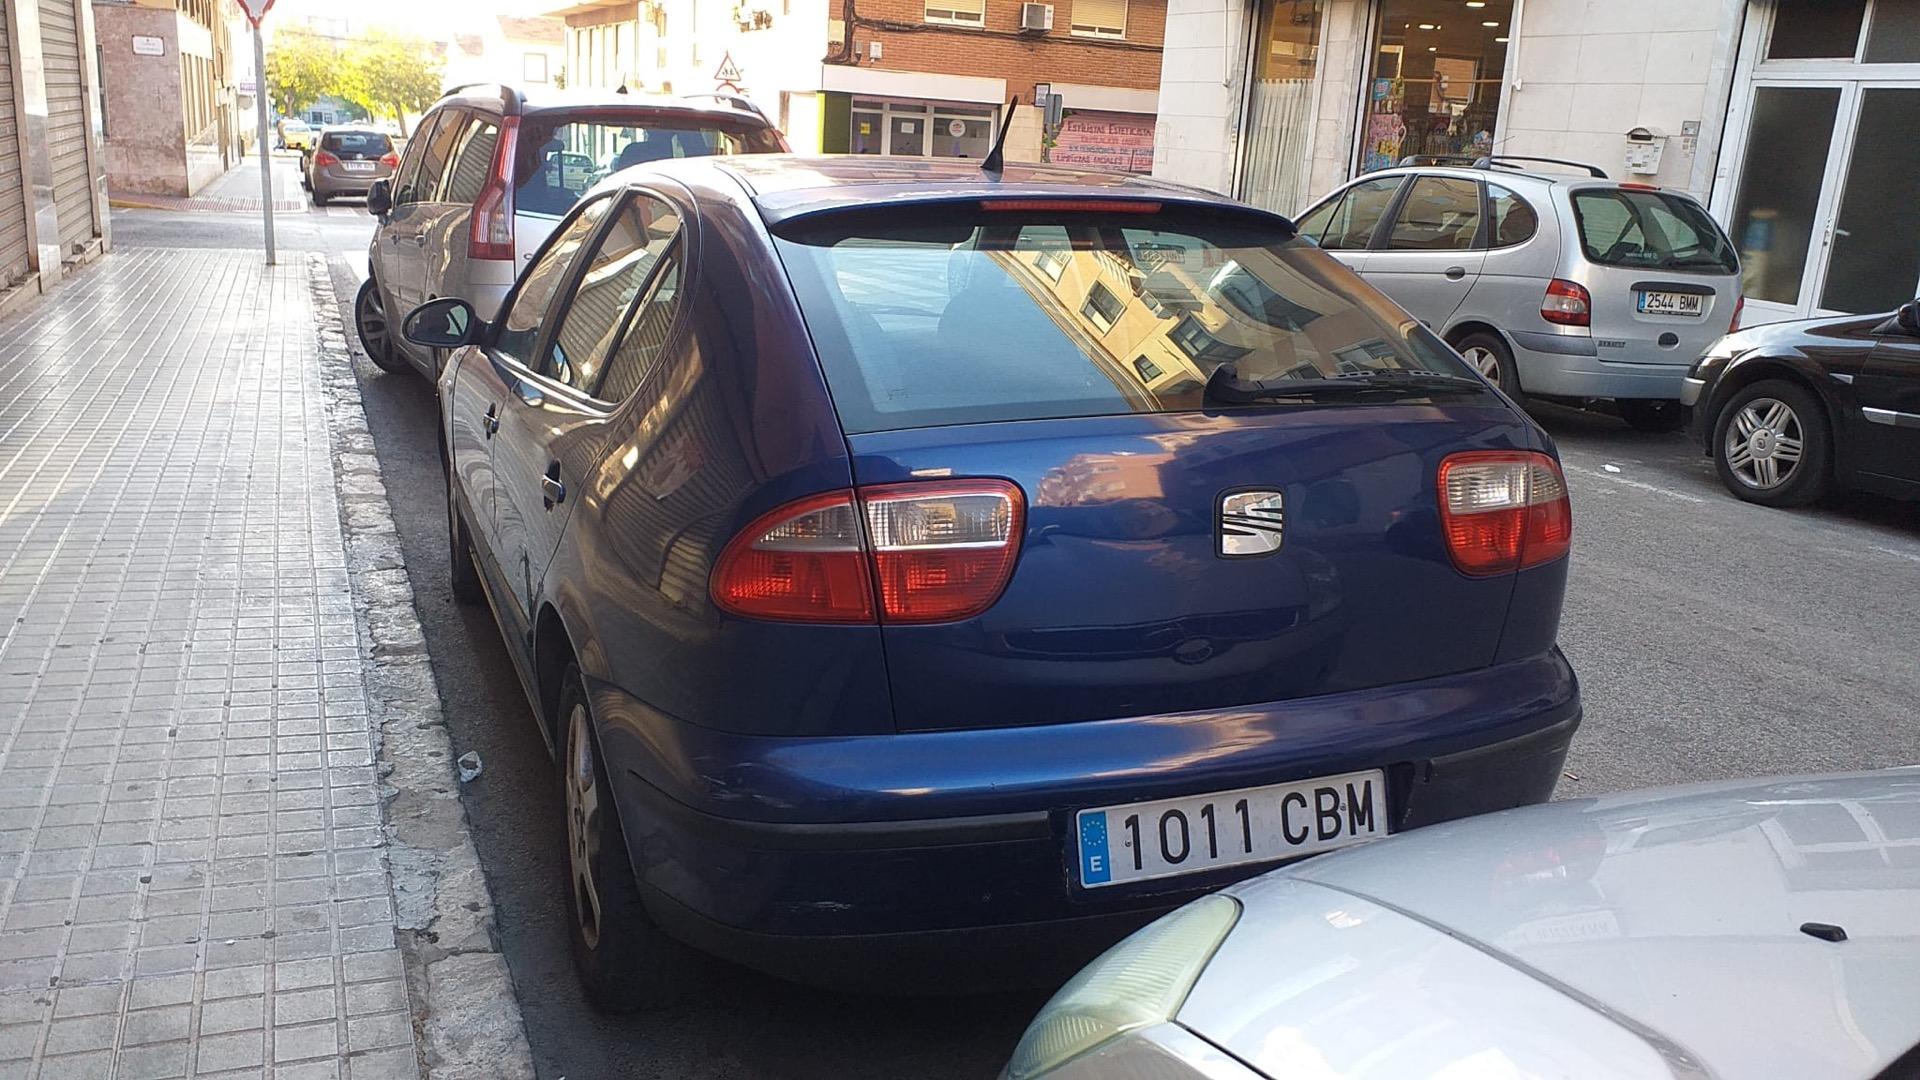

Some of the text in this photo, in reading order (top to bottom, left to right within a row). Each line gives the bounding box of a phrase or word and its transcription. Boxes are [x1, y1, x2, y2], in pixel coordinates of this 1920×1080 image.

[1647, 293, 1699, 311] 2544 BMM
[1090, 780, 1375, 873] E 1011 CBM
